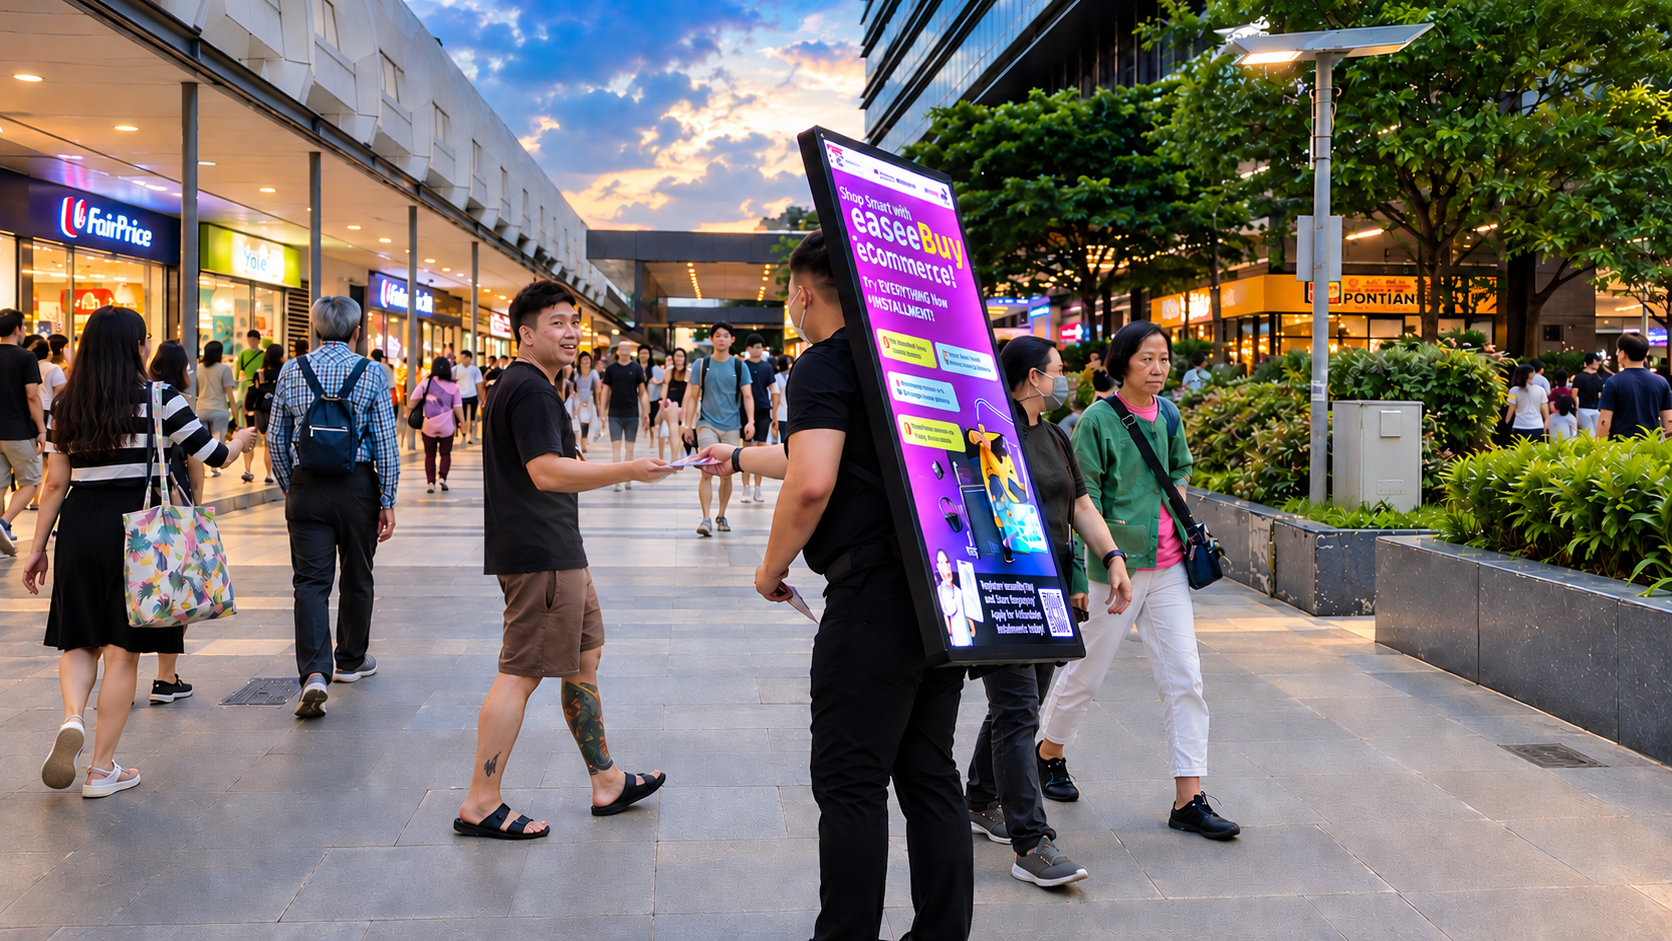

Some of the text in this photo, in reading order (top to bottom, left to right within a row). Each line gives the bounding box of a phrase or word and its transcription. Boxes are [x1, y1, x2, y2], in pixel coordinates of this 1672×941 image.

[839, 186, 912, 221] Shop Smart with
[87, 206, 152, 248] FairPrice
[851, 207, 963, 269] easeeBuy
[862, 276, 878, 293] Try
